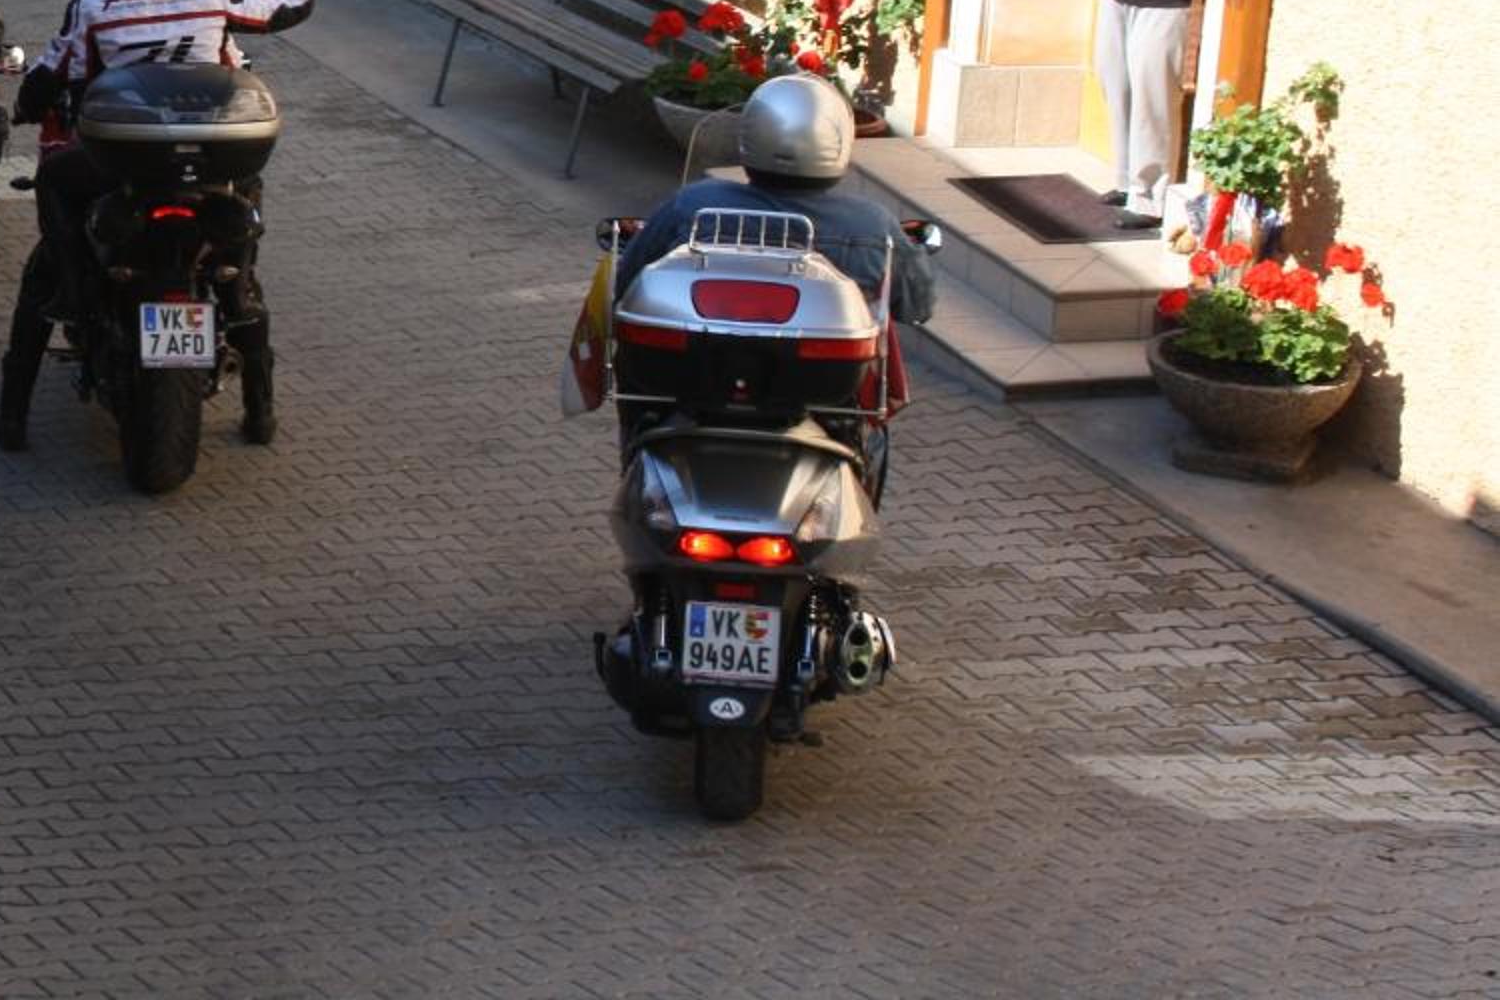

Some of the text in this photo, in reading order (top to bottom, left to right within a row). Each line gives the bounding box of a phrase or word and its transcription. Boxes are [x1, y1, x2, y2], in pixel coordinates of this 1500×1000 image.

[160, 308, 182, 330] VK
[712, 609, 740, 638] VK
[689, 642, 771, 674] 949AE
